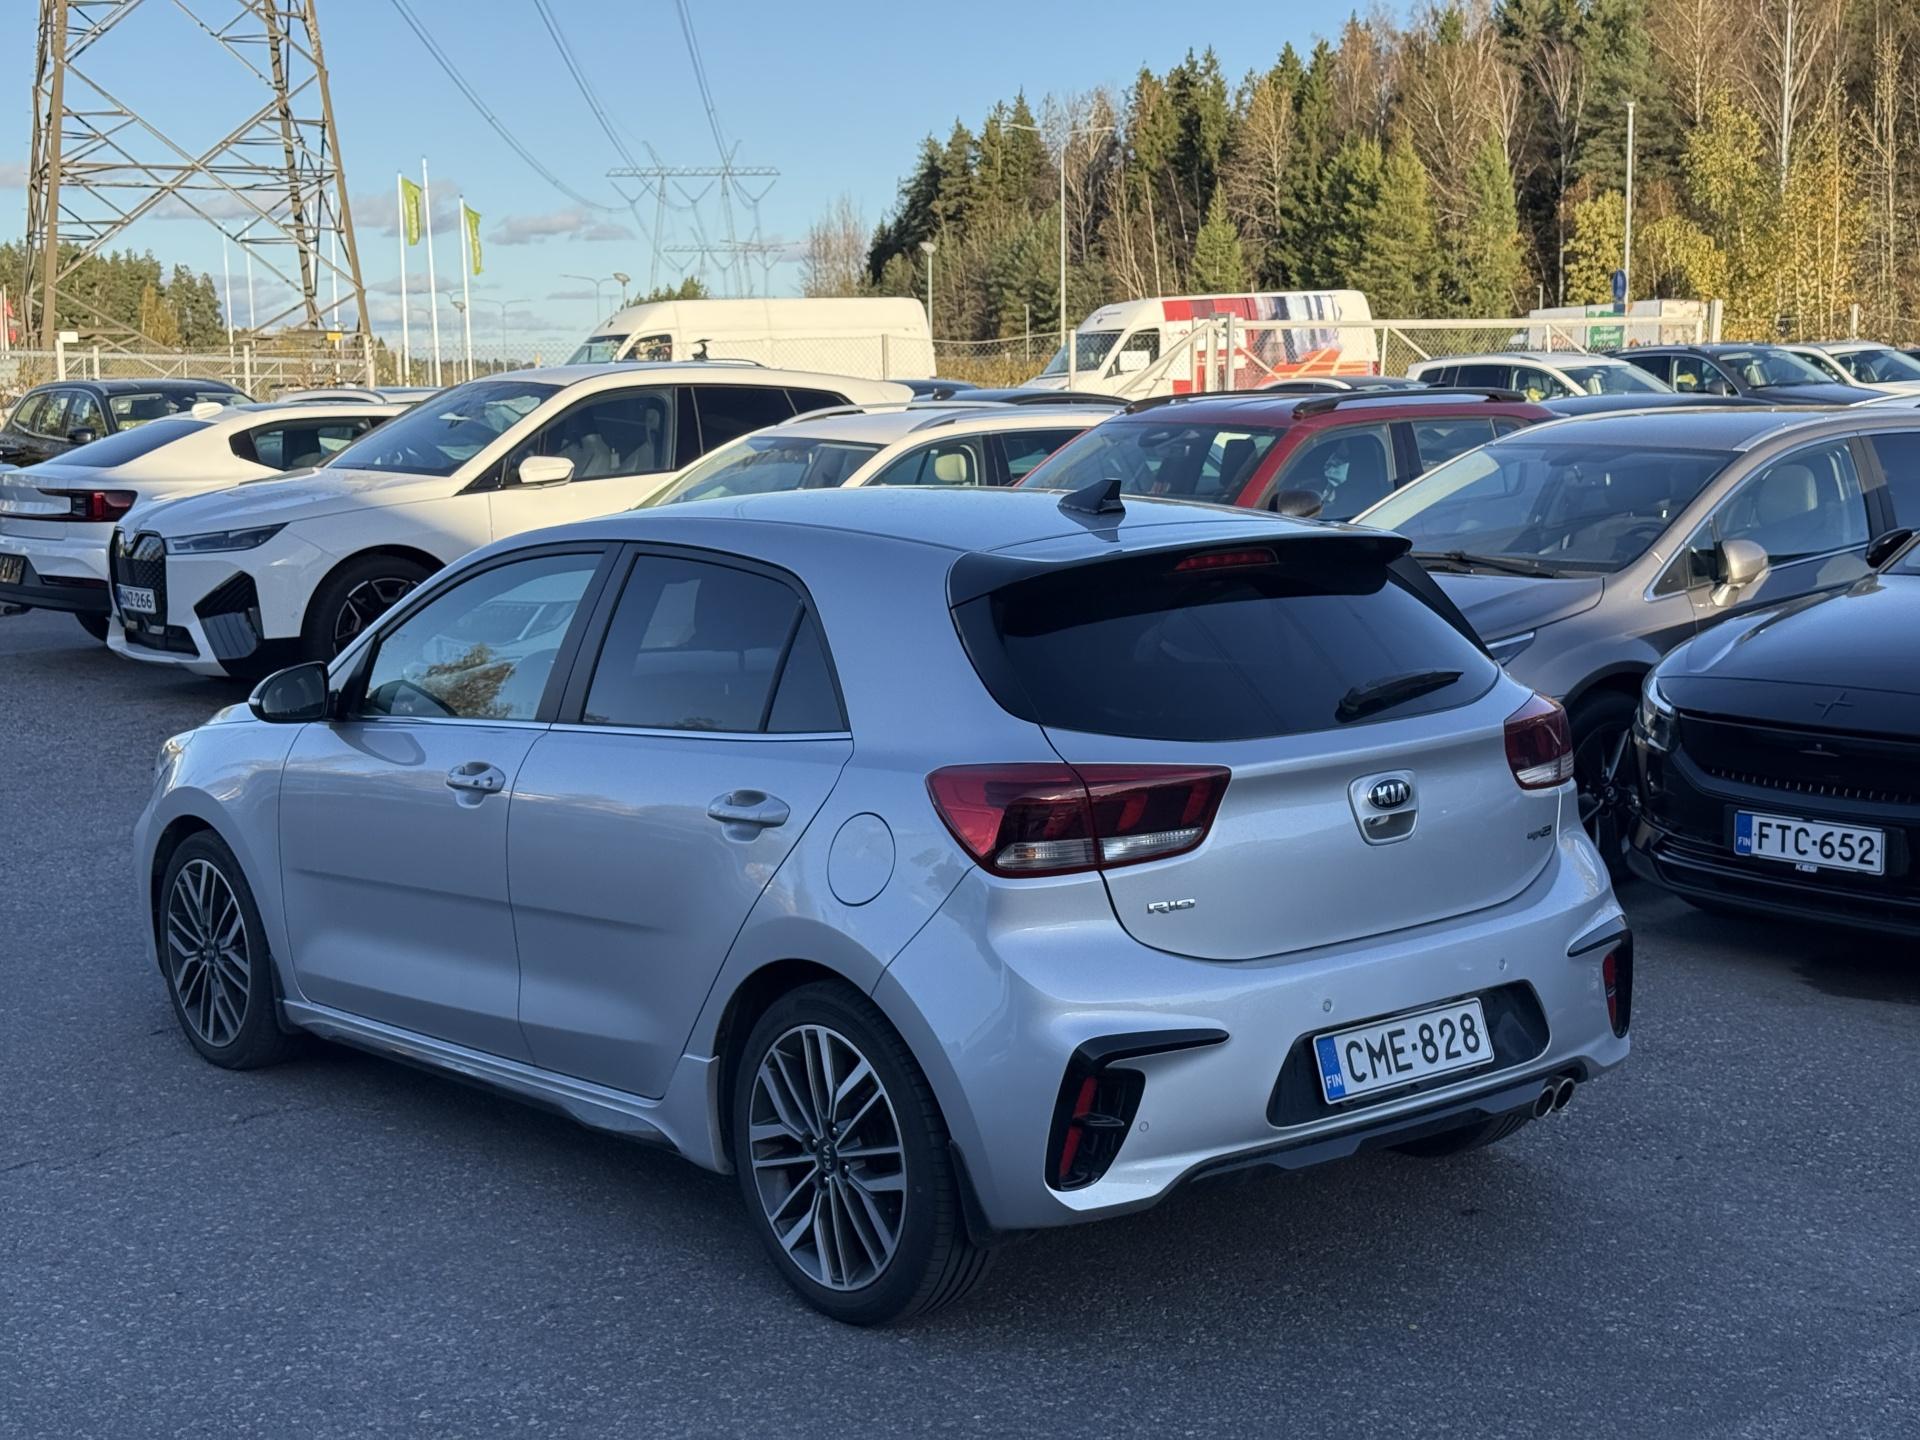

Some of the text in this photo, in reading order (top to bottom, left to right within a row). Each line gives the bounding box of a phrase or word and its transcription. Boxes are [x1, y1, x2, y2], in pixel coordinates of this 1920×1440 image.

[1376, 783, 1408, 804] KIA
[1737, 821, 1875, 866] FIN FTC-652
[1147, 898, 1195, 914] RIO
[1325, 1012, 1480, 1089] FIN CME-828
[822, 1144, 832, 1169] KIA
